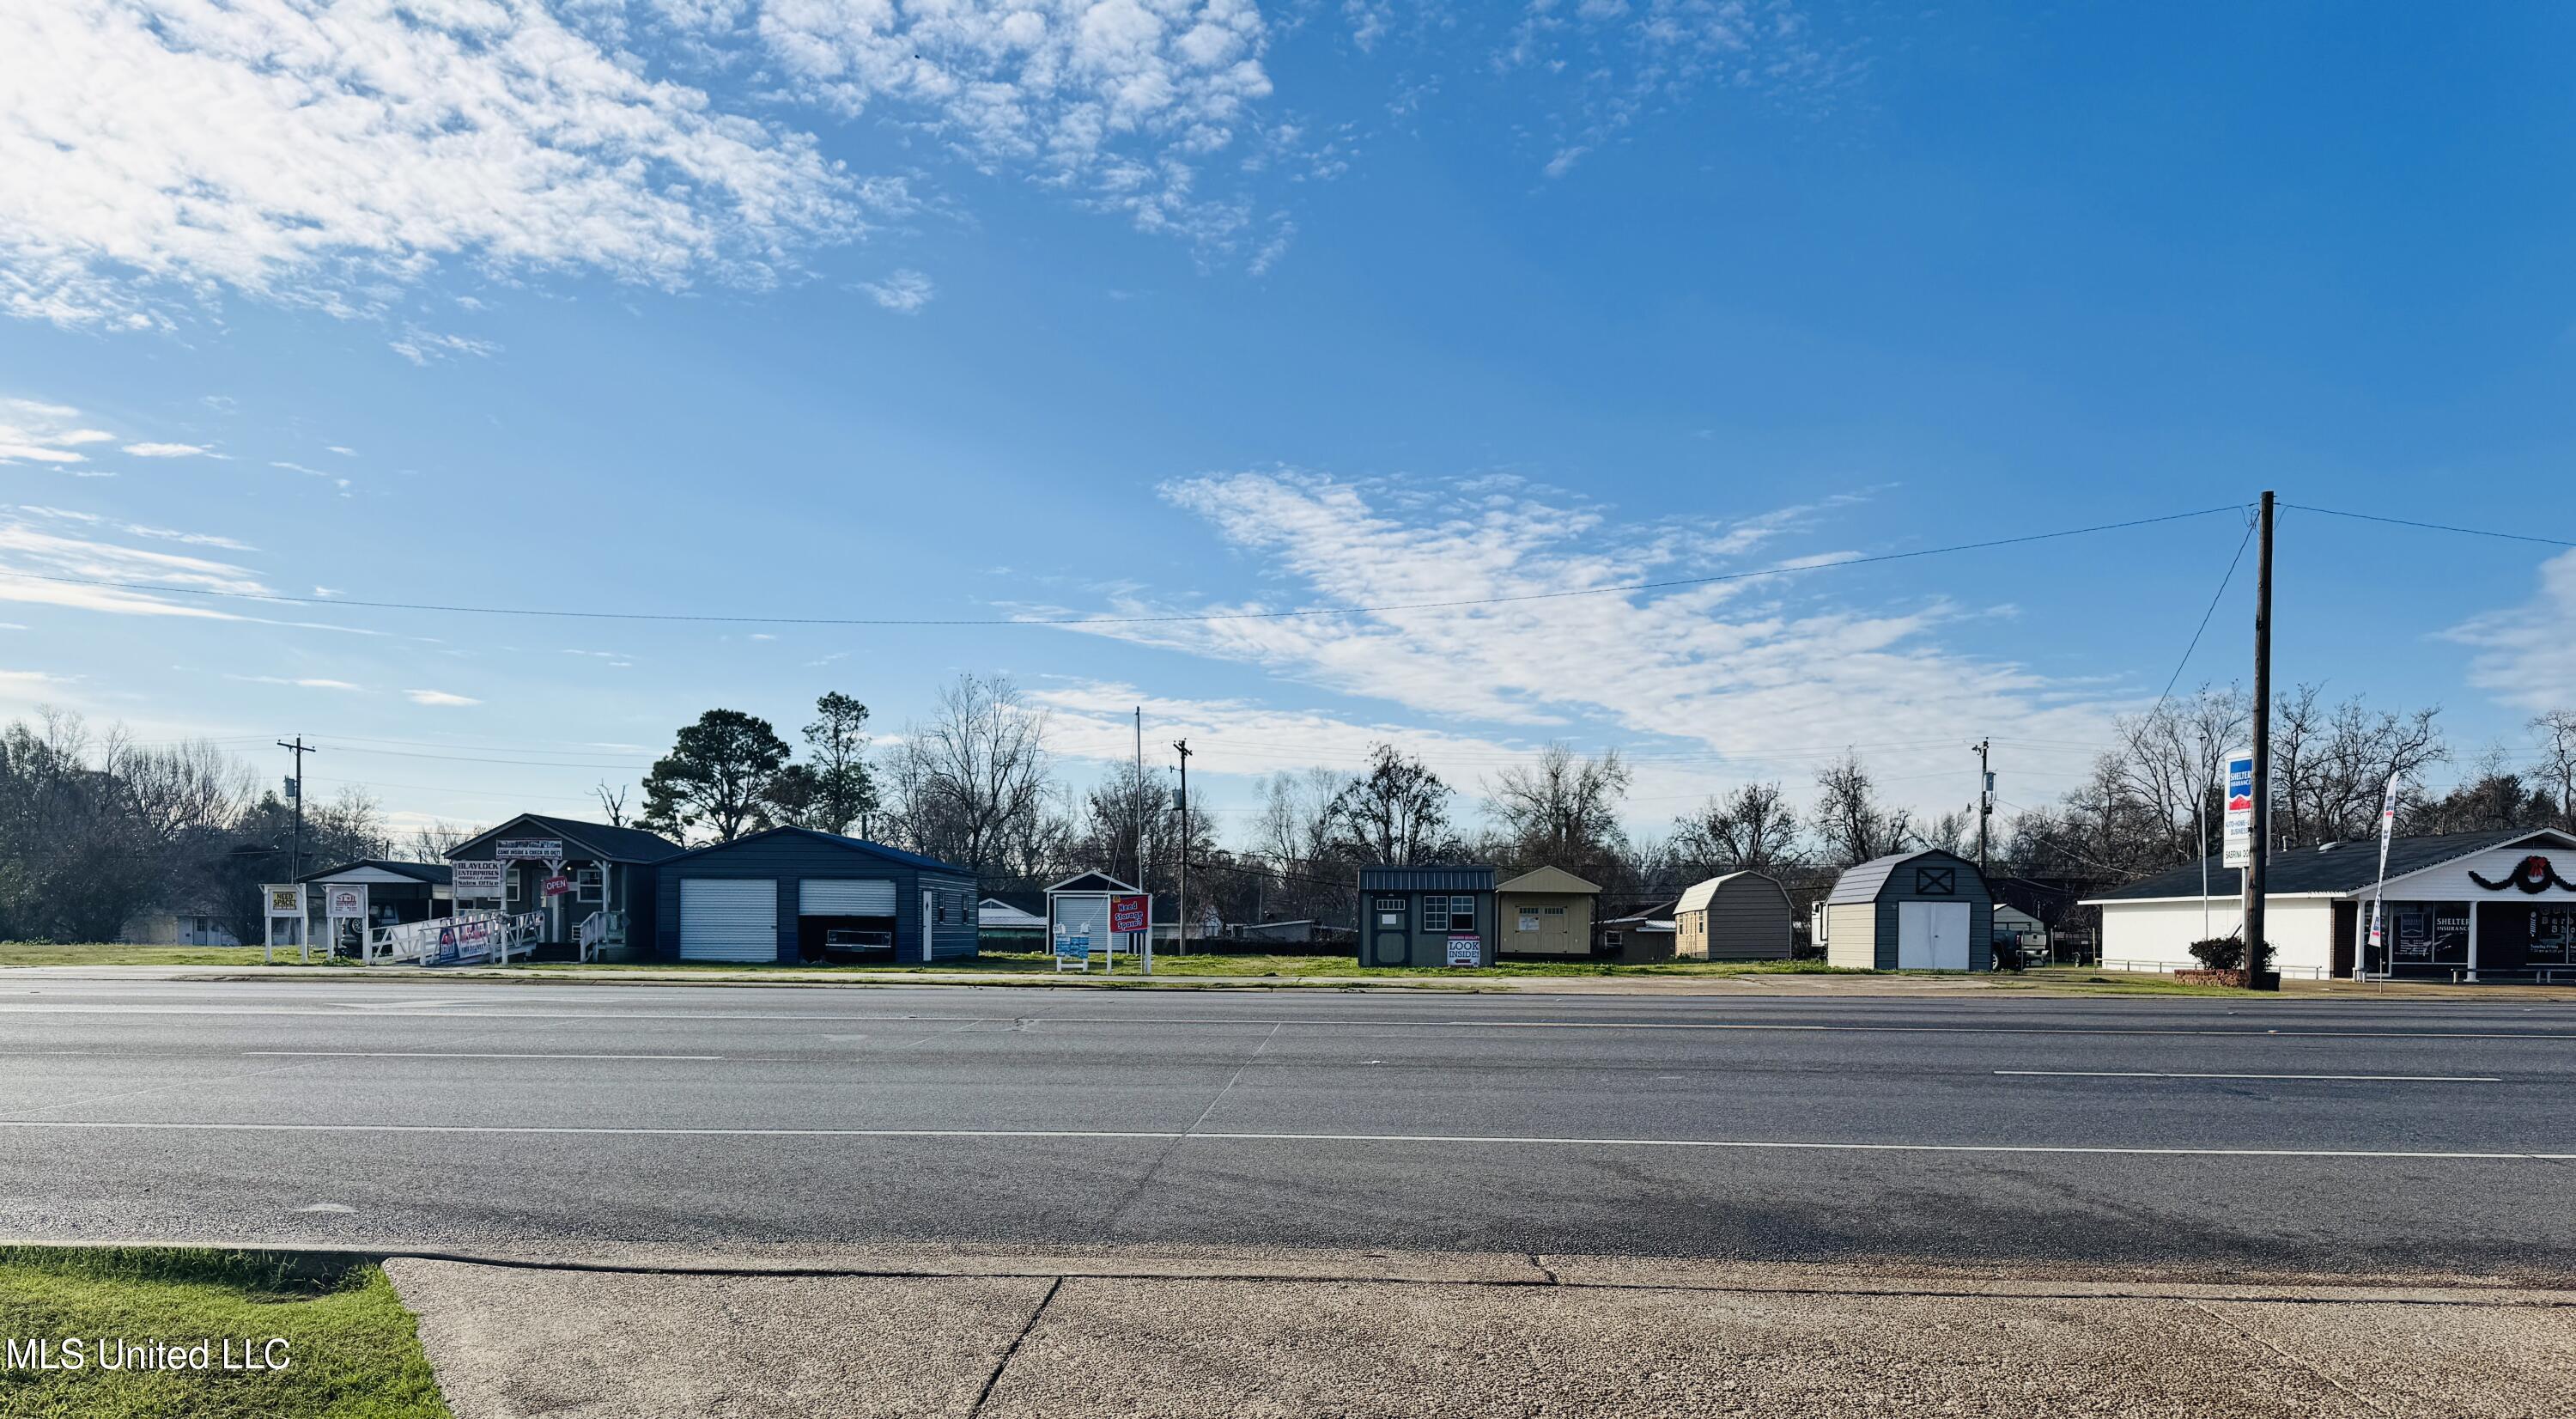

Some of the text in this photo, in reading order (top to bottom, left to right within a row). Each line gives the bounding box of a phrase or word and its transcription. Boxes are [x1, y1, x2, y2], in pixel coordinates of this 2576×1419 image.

[2230, 770, 2251, 781] SHELTER
[546, 880, 566, 890] OPEN
[1117, 901, 1138, 912] Need
[1115, 911, 1143, 922] Storage
[1117, 918, 1143, 931] Space?
[1449, 941, 1479, 950] LOOK
